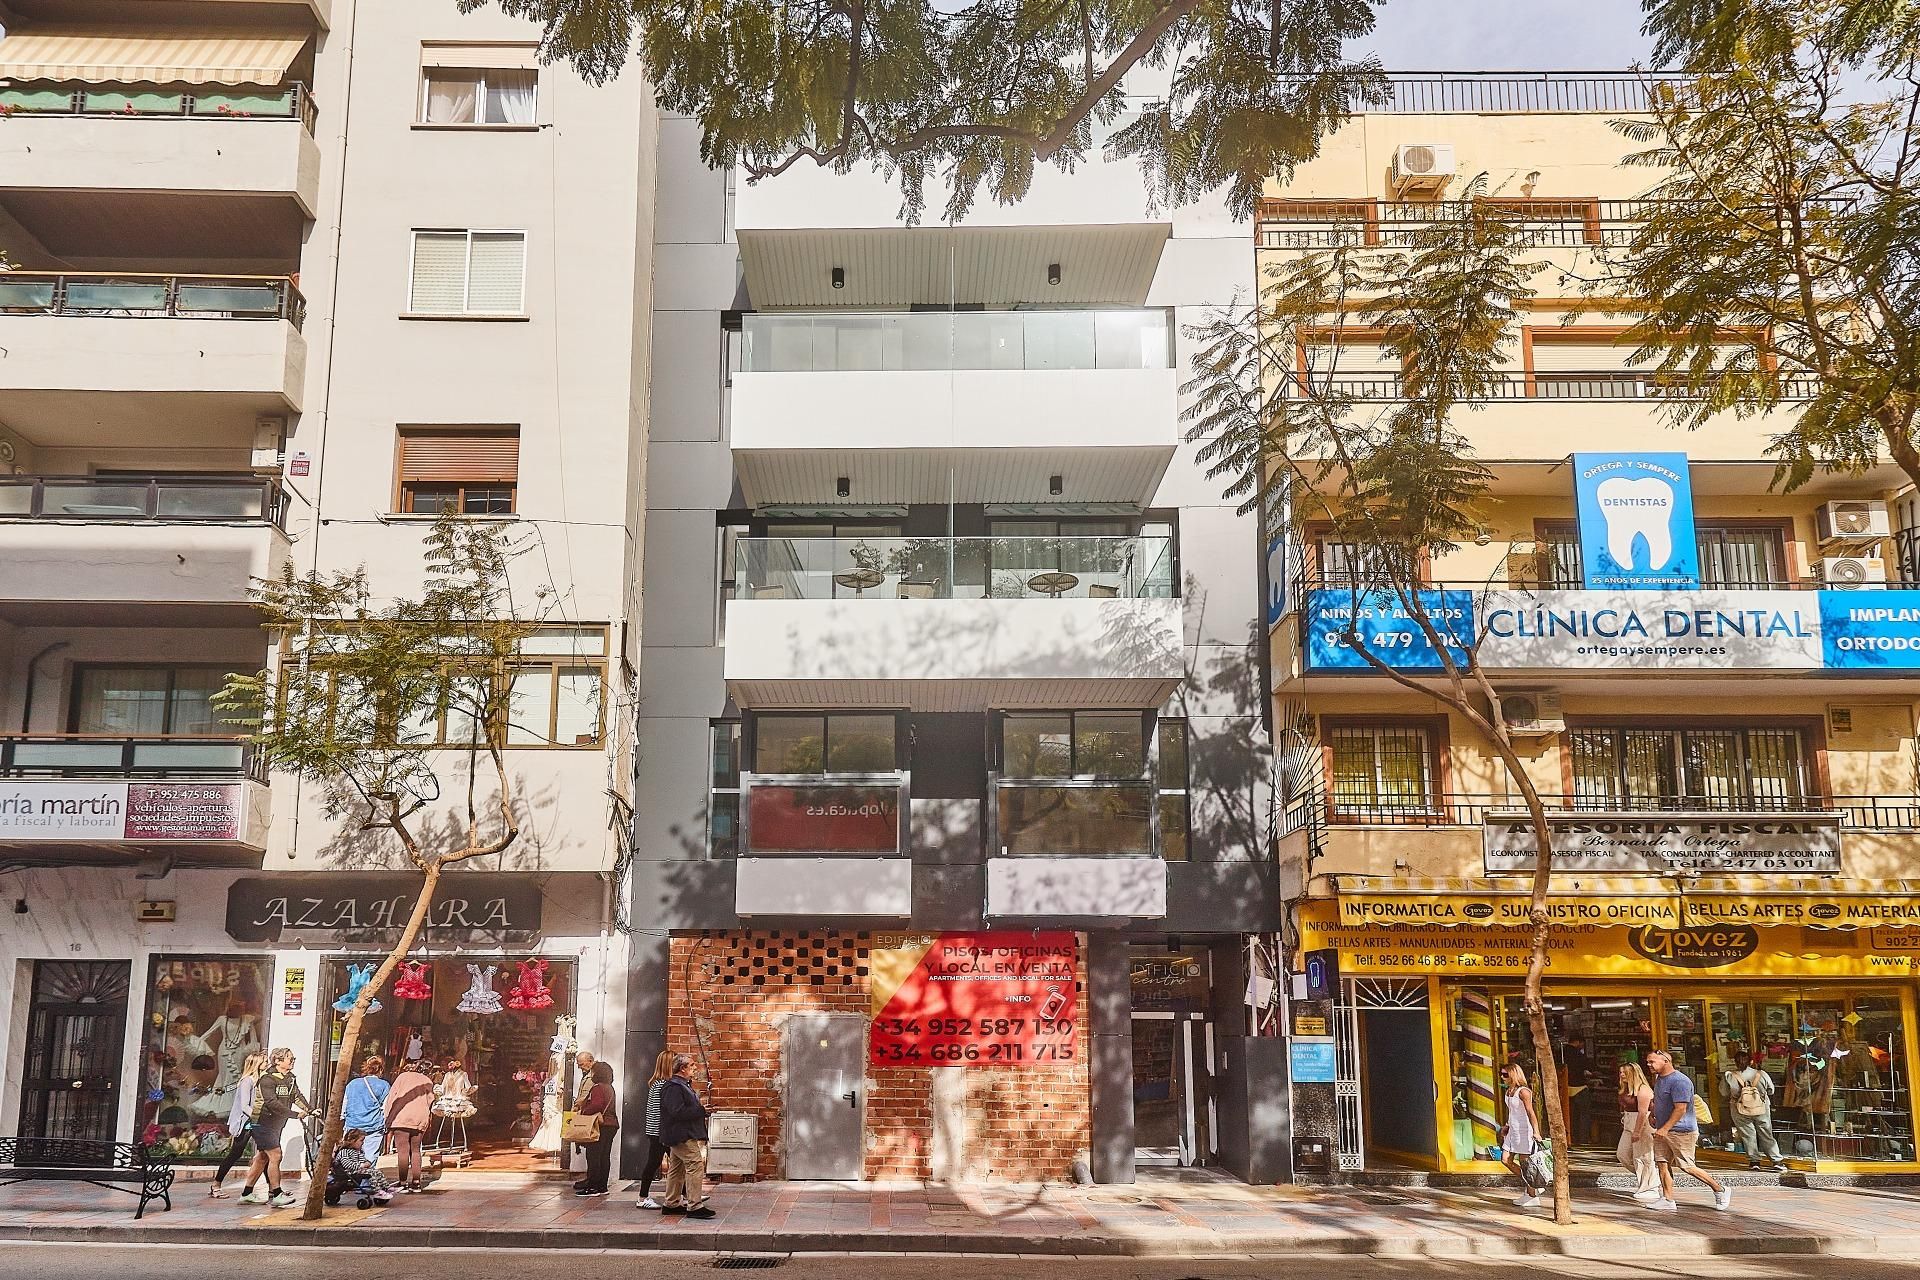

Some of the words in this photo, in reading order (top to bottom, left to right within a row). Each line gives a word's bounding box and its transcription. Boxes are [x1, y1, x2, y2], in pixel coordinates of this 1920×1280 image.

[1584, 461, 1623, 479] ORTEGA
[1637, 461, 1682, 482] SEMPERE
[1604, 498, 1667, 506] DENTISTAS
[1378, 609, 1387, 618] Y
[1487, 602, 1648, 638] CLÍNICA
[1664, 610, 1813, 638] DENTAL
[1373, 632, 1413, 648] 479
[1577, 646, 1726, 657] ortegaysempere.es
[161, 790, 178, 799] 952
[181, 790, 199, 799] 475
[203, 790, 221, 799] 886
[0, 793, 33, 814] ría
[41, 794, 119, 815] martín
[14, 815, 51, 826] fiscal
[58, 819, 64, 828] y
[70, 815, 116, 826] laboral
[1507, 822, 1681, 834] AESORIA
[1701, 822, 1818, 834] FISCAL
[1582, 835, 1668, 847] Bernardo
[1684, 835, 1741, 850] Ortega
[1551, 850, 1582, 858] ASESOR
[1585, 850, 1614, 858] FISCAL
[1641, 850, 1657, 858] TAX
[1778, 850, 1836, 858] ACCOUNTANT
[1663, 859, 1715, 868] Telf.
[1723, 859, 1756, 868] 247
[1764, 859, 1786, 868] 03
[1794, 859, 1814, 868] 01
[1346, 903, 1455, 917] INFORMATICA
[1501, 905, 1600, 918] SUMNISTRO
[1607, 906, 1673, 919] OFICINA
[1690, 903, 1748, 917] BELLAS
[1753, 904, 1803, 917] ARTES
[1847, 905, 1920, 917] MATERIA
[1380, 923, 1435, 933] MOBILIARIO
[1455, 924, 1492, 933] OFICINA
[877, 935, 930, 944] EDIFICIO
[1328, 938, 1360, 948] BELLAS
[1364, 938, 1391, 948] ARTES
[1400, 938, 1475, 948] MANUALIDADES
[1484, 939, 1530, 949] MATERIAL
[1640, 924, 1747, 958] Govez
[1886, 938, 1907, 946] 902
[69, 943, 82, 951] 16
[998, 947, 1072, 958] OFICINAS
[1355, 954, 1376, 965] Telf.
[1380, 954, 1398, 965] 952
[1402, 954, 1415, 965] 66
[1418, 954, 1431, 965] 46
[1434, 954, 1447, 965] 88
[1458, 956, 1480, 967] Fax.
[1484, 956, 1503, 967] 952
[1506, 956, 1519, 967] 66
[925, 963, 932, 973] Y
[940, 963, 990, 973] LOCAL
[995, 963, 1014, 973] EN
[1019, 963, 1072, 973] VENTA
[929, 975, 973, 983] APARTMENTS,
[1005, 995, 1031, 1003] +INFO
[877, 1018, 921, 1036] +34
[928, 1018, 972, 1036] 952
[980, 1018, 1025, 1036] 587
[1034, 1018, 1072, 1036] 130
[877, 1043, 922, 1061] +34
[930, 1043, 980, 1061] 686
[988, 1043, 1022, 1061] 211
[1032, 1043, 1073, 1061] 715
